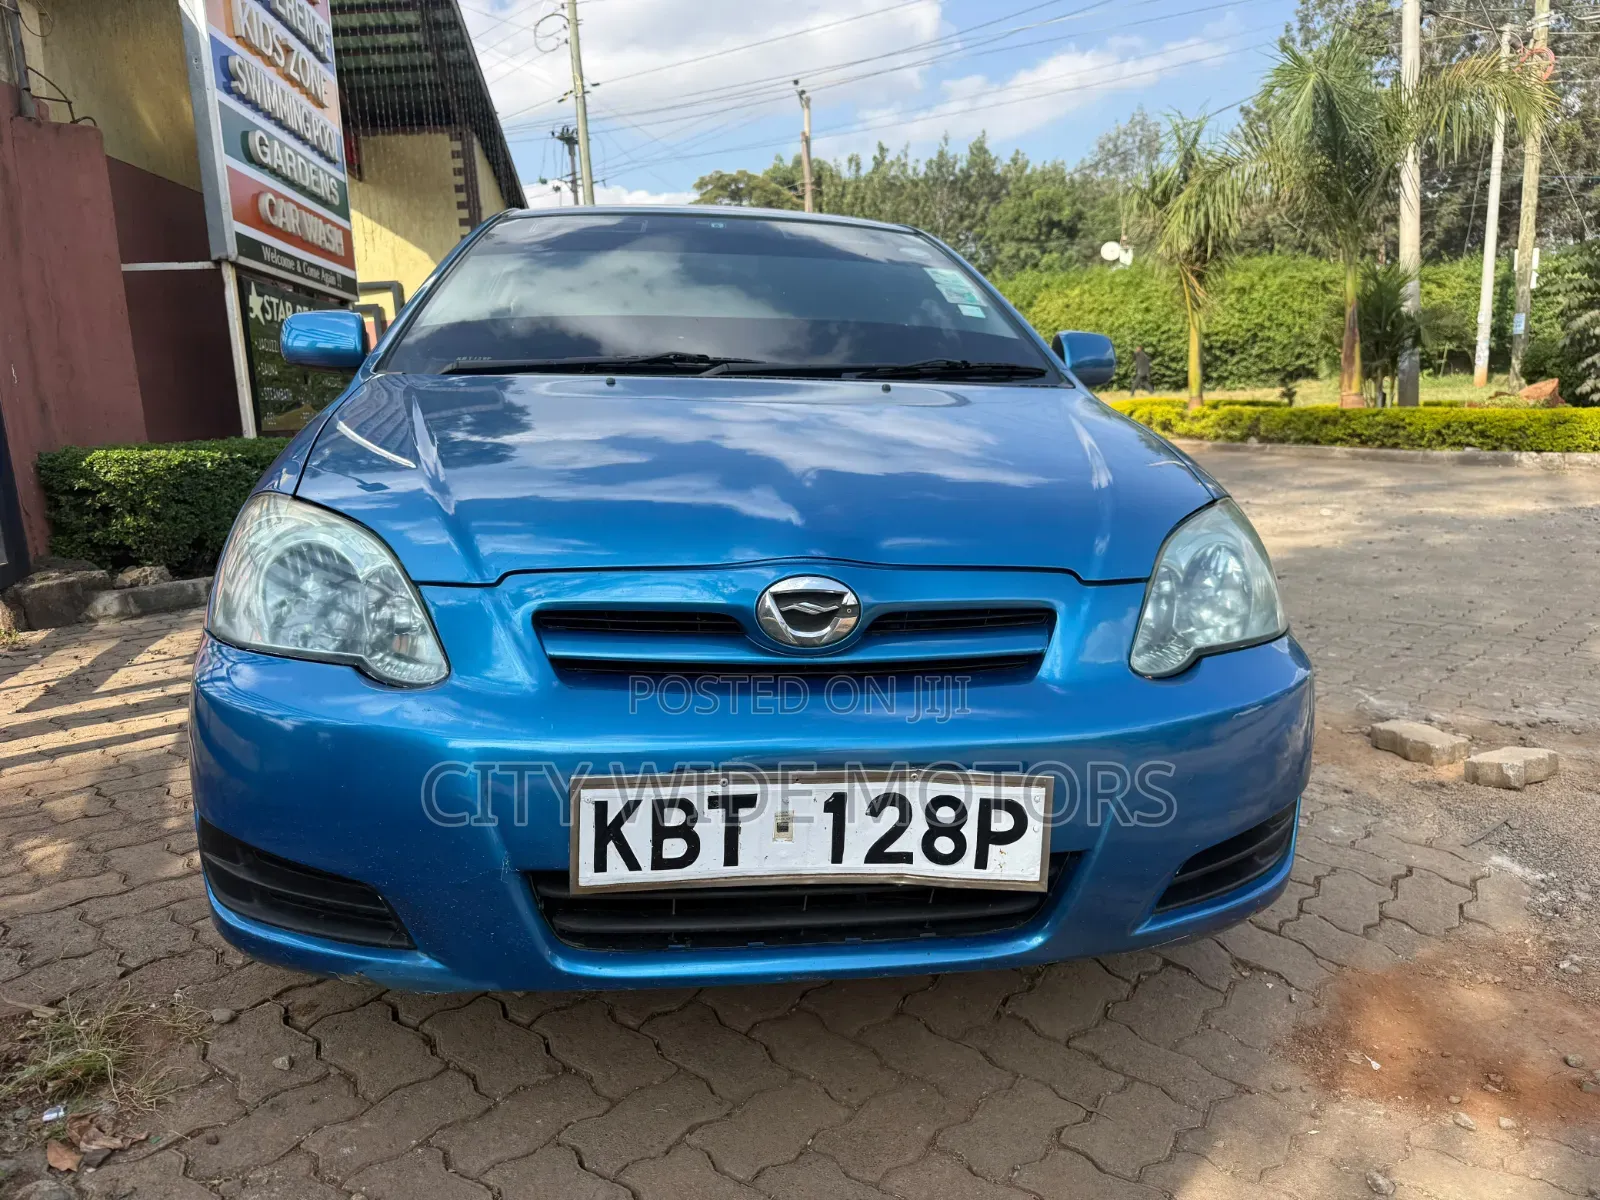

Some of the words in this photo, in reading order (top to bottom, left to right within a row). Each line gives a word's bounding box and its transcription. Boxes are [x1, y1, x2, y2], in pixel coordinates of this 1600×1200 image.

[233, 0, 285, 67] KIDS
[281, 38, 329, 108] ZONE
[229, 55, 312, 141] SWIMMING
[311, 115, 339, 163] POOL
[248, 130, 340, 206] GARDENS
[258, 192, 301, 236] CAR
[300, 211, 345, 257] WASH
[261, 245, 295, 270] Welcome
[303, 261, 320, 279] Come
[321, 268, 336, 287] Again
[593, 792, 759, 872] KBT
[823, 792, 1029, 870] 128P
